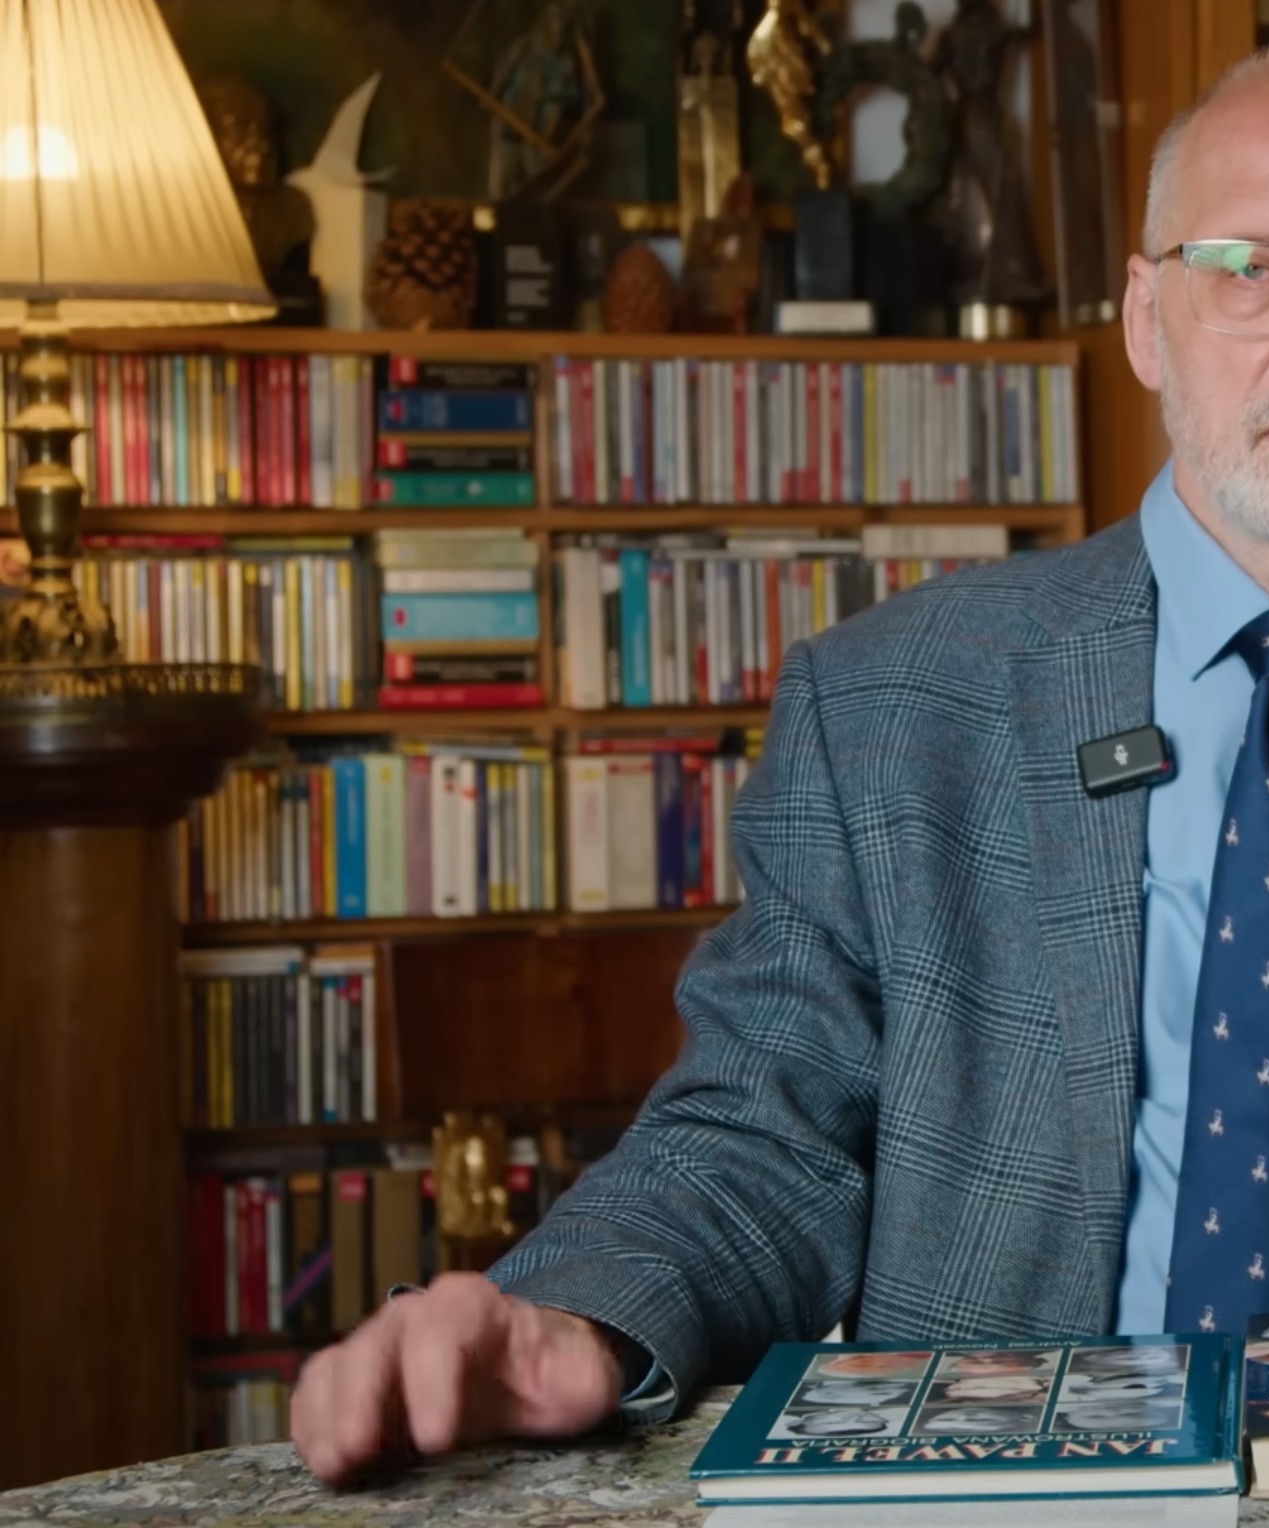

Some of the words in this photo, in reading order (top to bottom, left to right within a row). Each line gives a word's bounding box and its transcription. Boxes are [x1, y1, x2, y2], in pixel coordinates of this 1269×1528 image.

[1008, 1340, 1082, 1348] Andrzej
[790, 1437, 937, 1447] BIOGRAFIA
[952, 1431, 1152, 1444] ILUSTROWANA
[820, 1442, 1039, 1461] PAWEŁ
[1058, 1438, 1178, 1457] JAN
[755, 1448, 805, 1464] II
